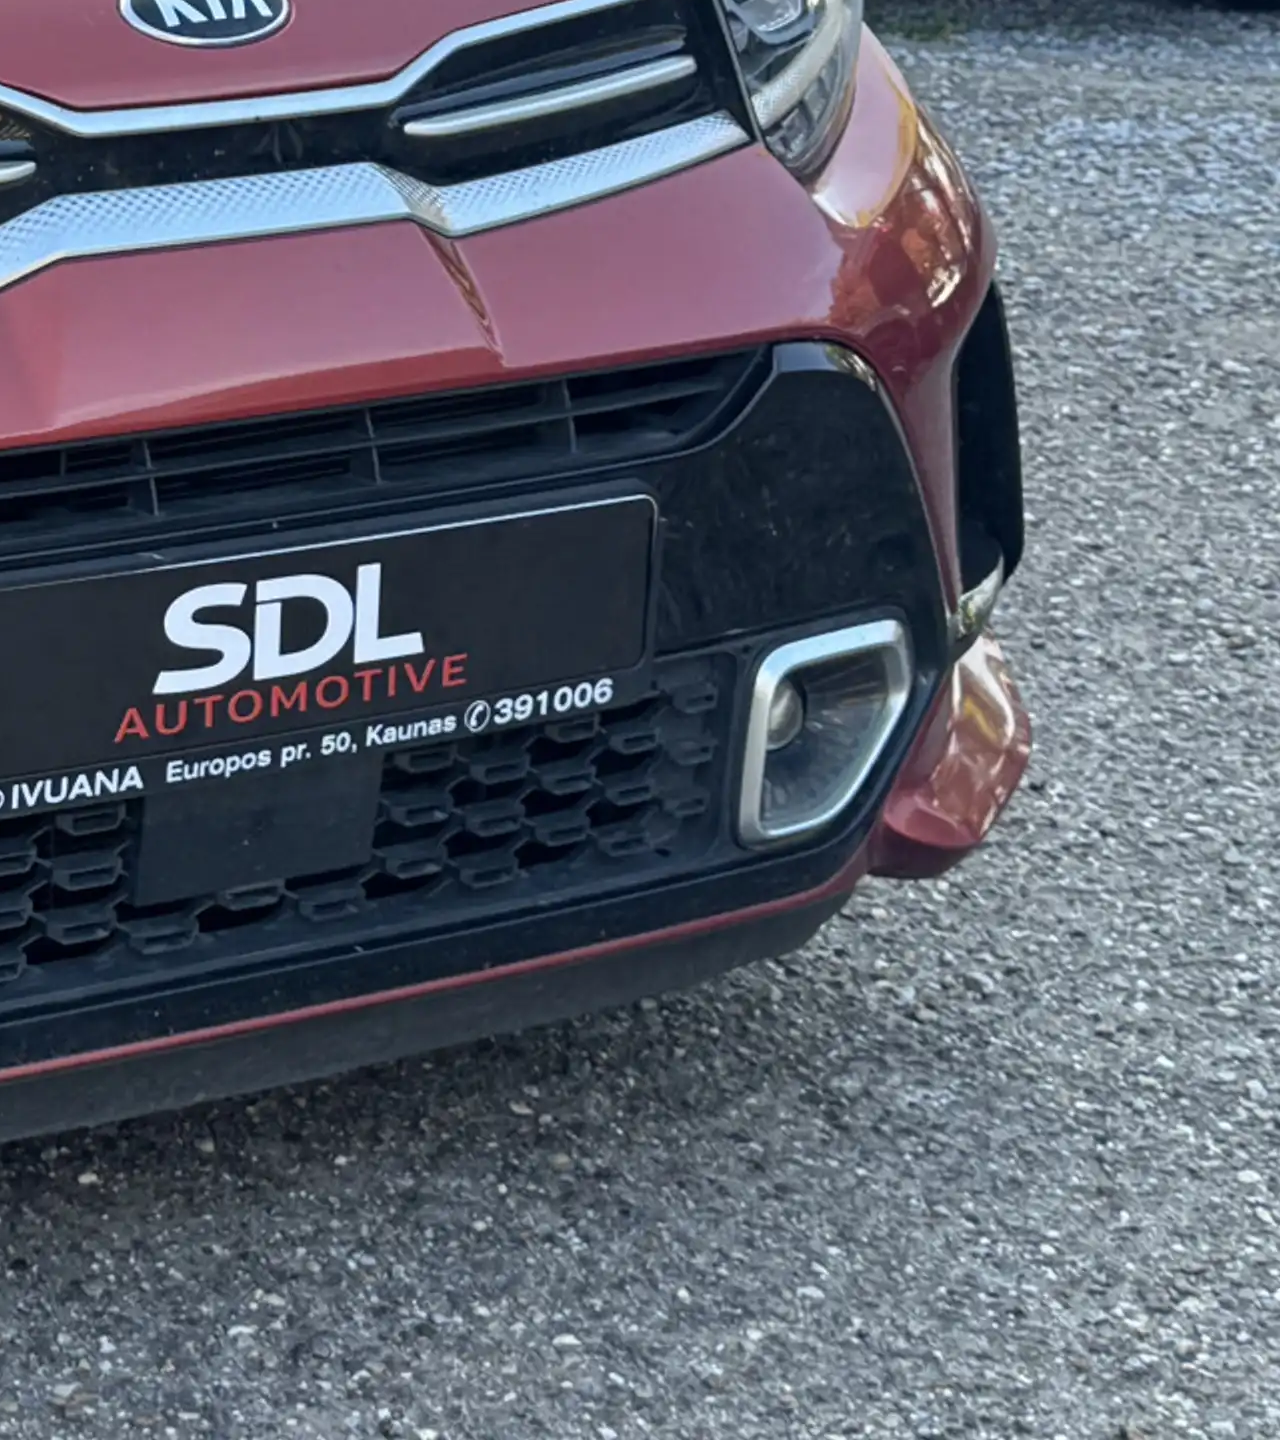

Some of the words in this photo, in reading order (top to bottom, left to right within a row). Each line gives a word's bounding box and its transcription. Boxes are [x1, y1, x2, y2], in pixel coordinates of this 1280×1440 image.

[152, 562, 425, 695] SDL
[11, 765, 144, 809] IVUANA
[165, 749, 272, 784] Europos
[279, 744, 312, 774] pr.
[320, 731, 358, 755] 50,
[365, 712, 457, 748] Kaunas
[493, 677, 614, 725] 391006
[114, 653, 468, 743] AUTOMOTIVE
